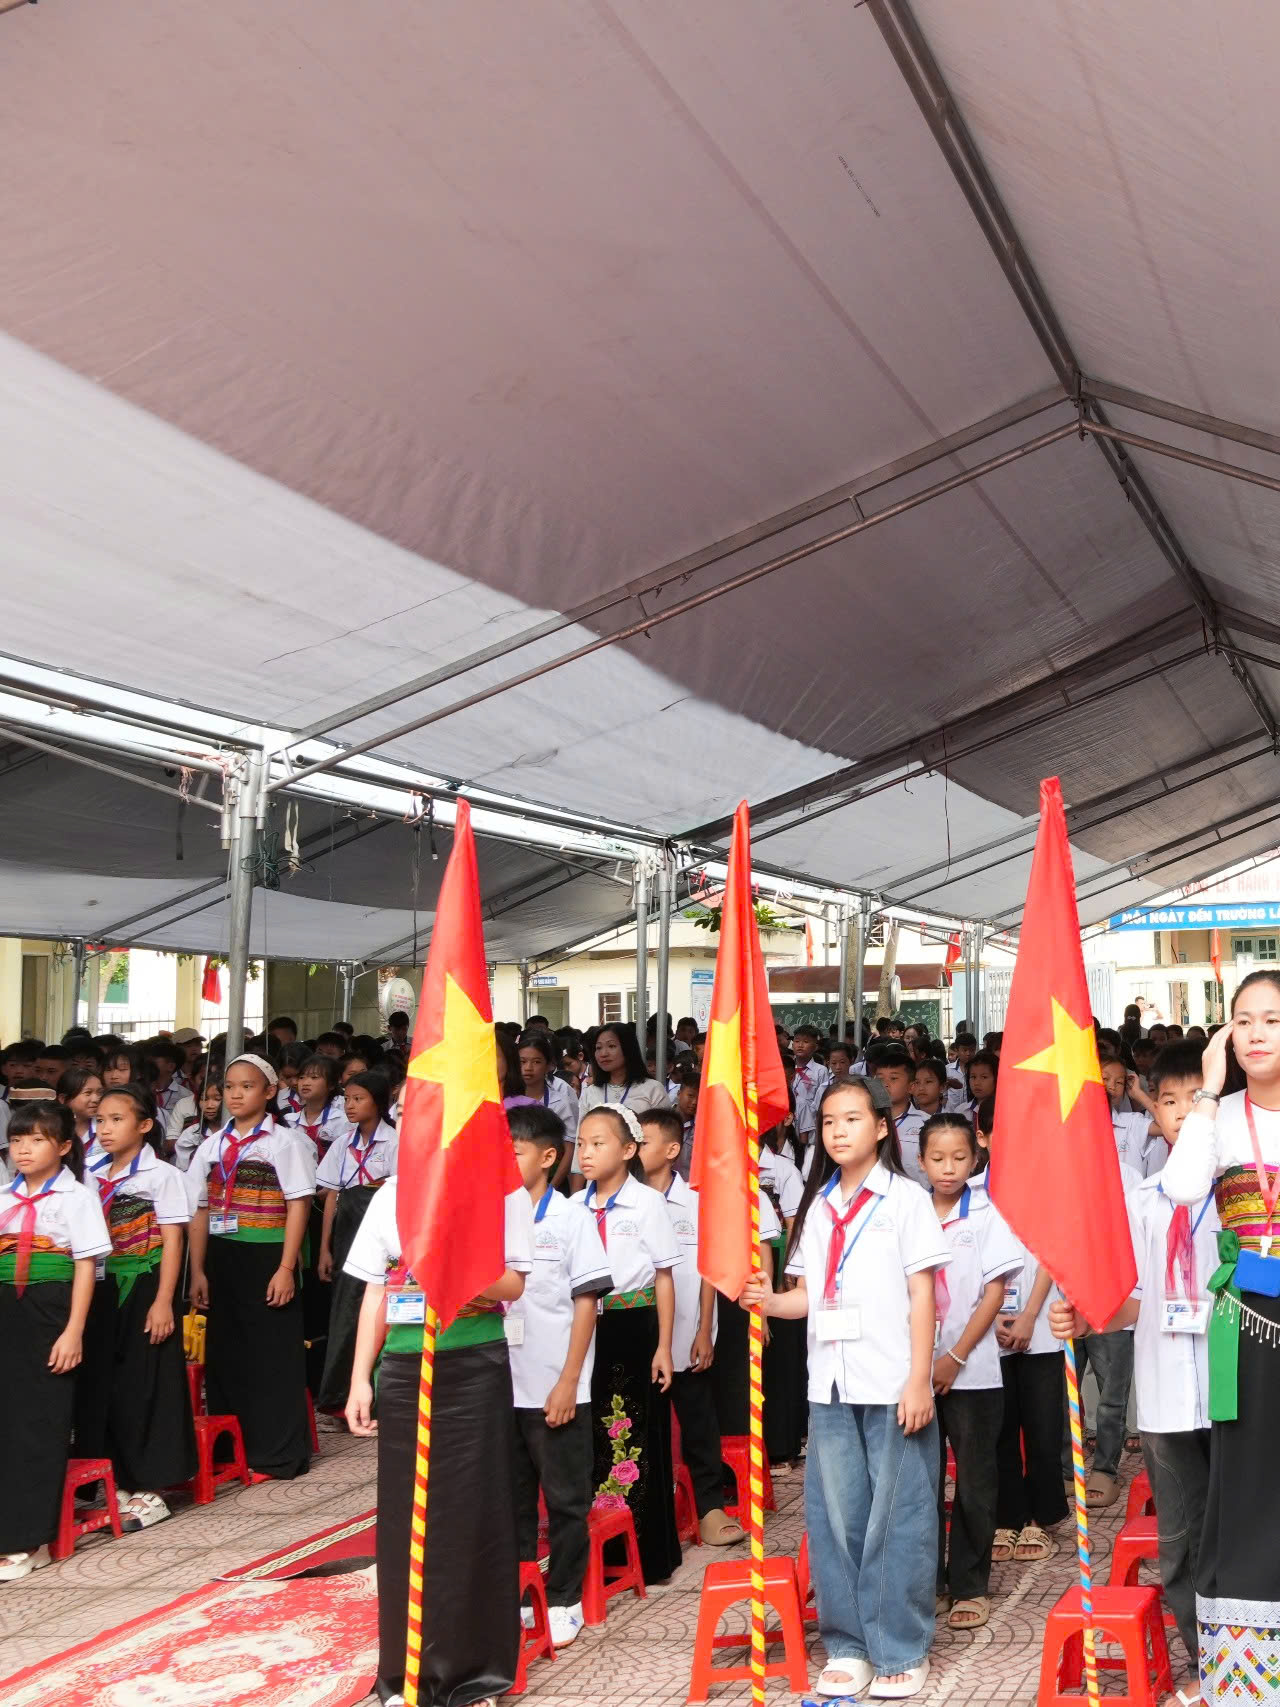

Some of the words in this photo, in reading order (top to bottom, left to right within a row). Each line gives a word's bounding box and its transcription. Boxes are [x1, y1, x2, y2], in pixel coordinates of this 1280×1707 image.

[1149, 909, 1186, 924] NGÀY
[1188, 907, 1213, 922] ĐẾN
[1215, 907, 1266, 921] TRƯỜNG
